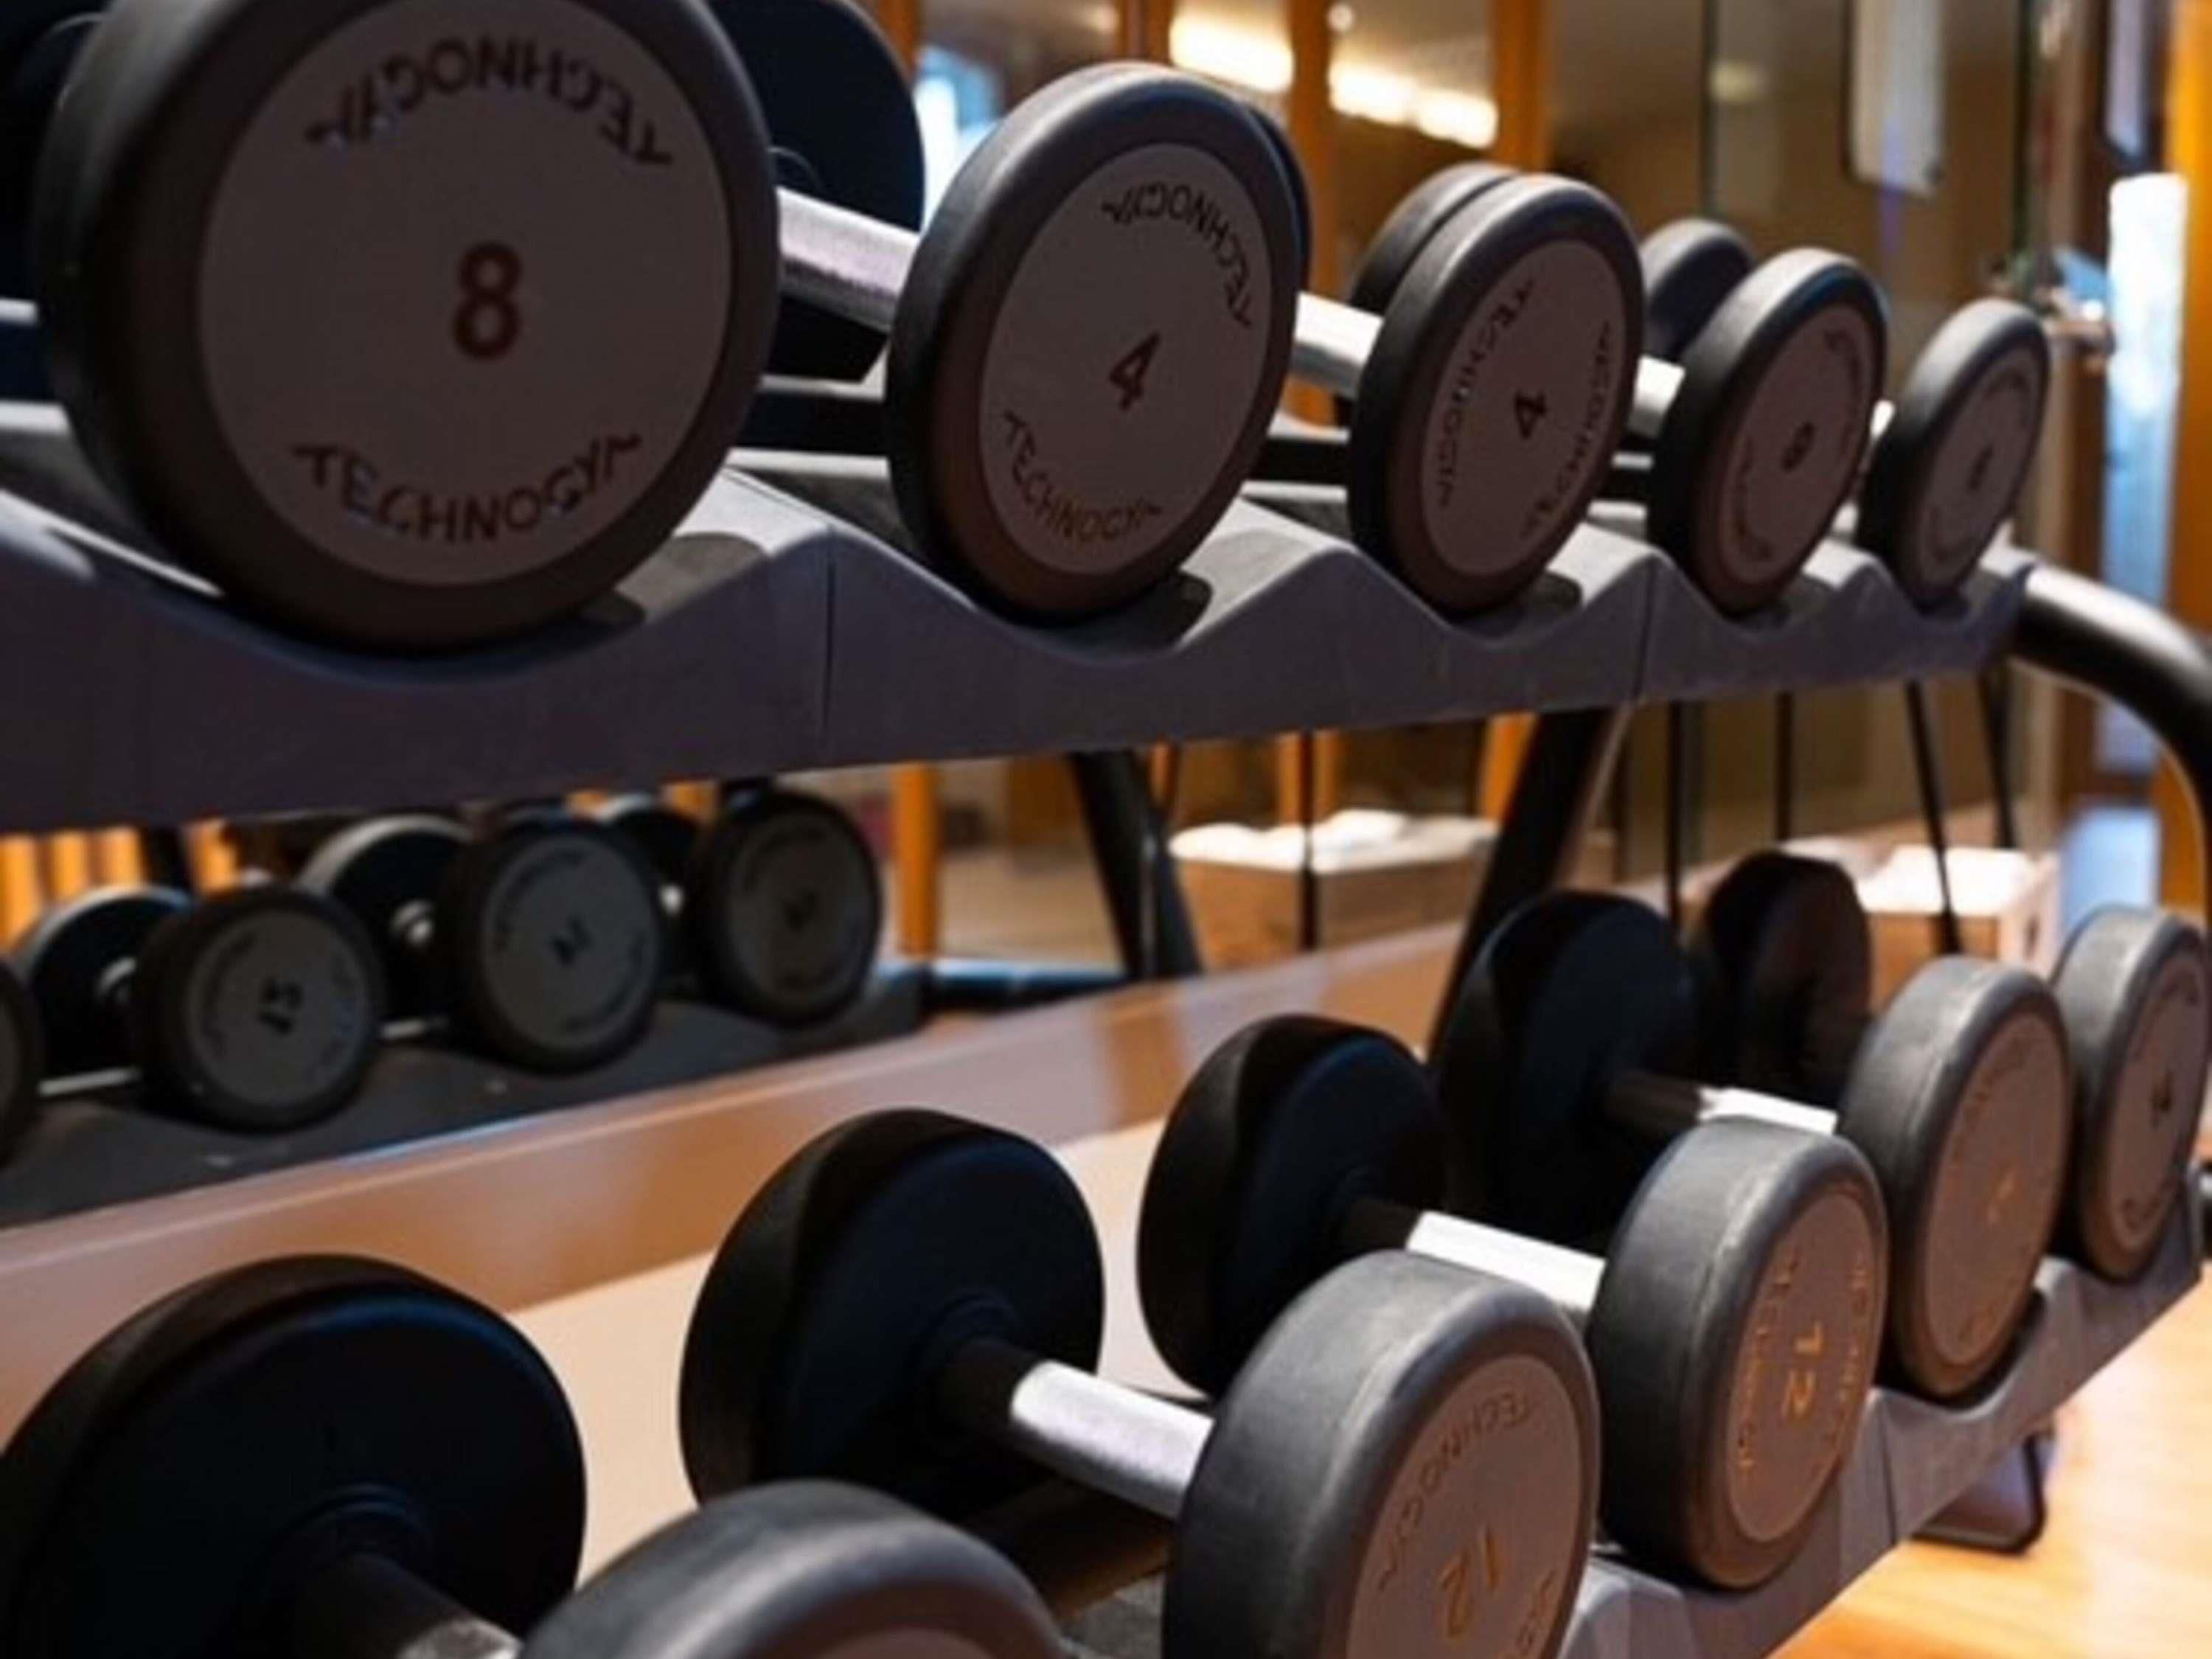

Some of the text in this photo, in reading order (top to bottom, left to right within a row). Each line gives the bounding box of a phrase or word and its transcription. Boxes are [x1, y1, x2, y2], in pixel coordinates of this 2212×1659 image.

[452, 240, 521, 358] 8
[1109, 332, 1161, 411] 4
[1513, 388, 1548, 439] 4
[1781, 1321, 1824, 1419] 12
